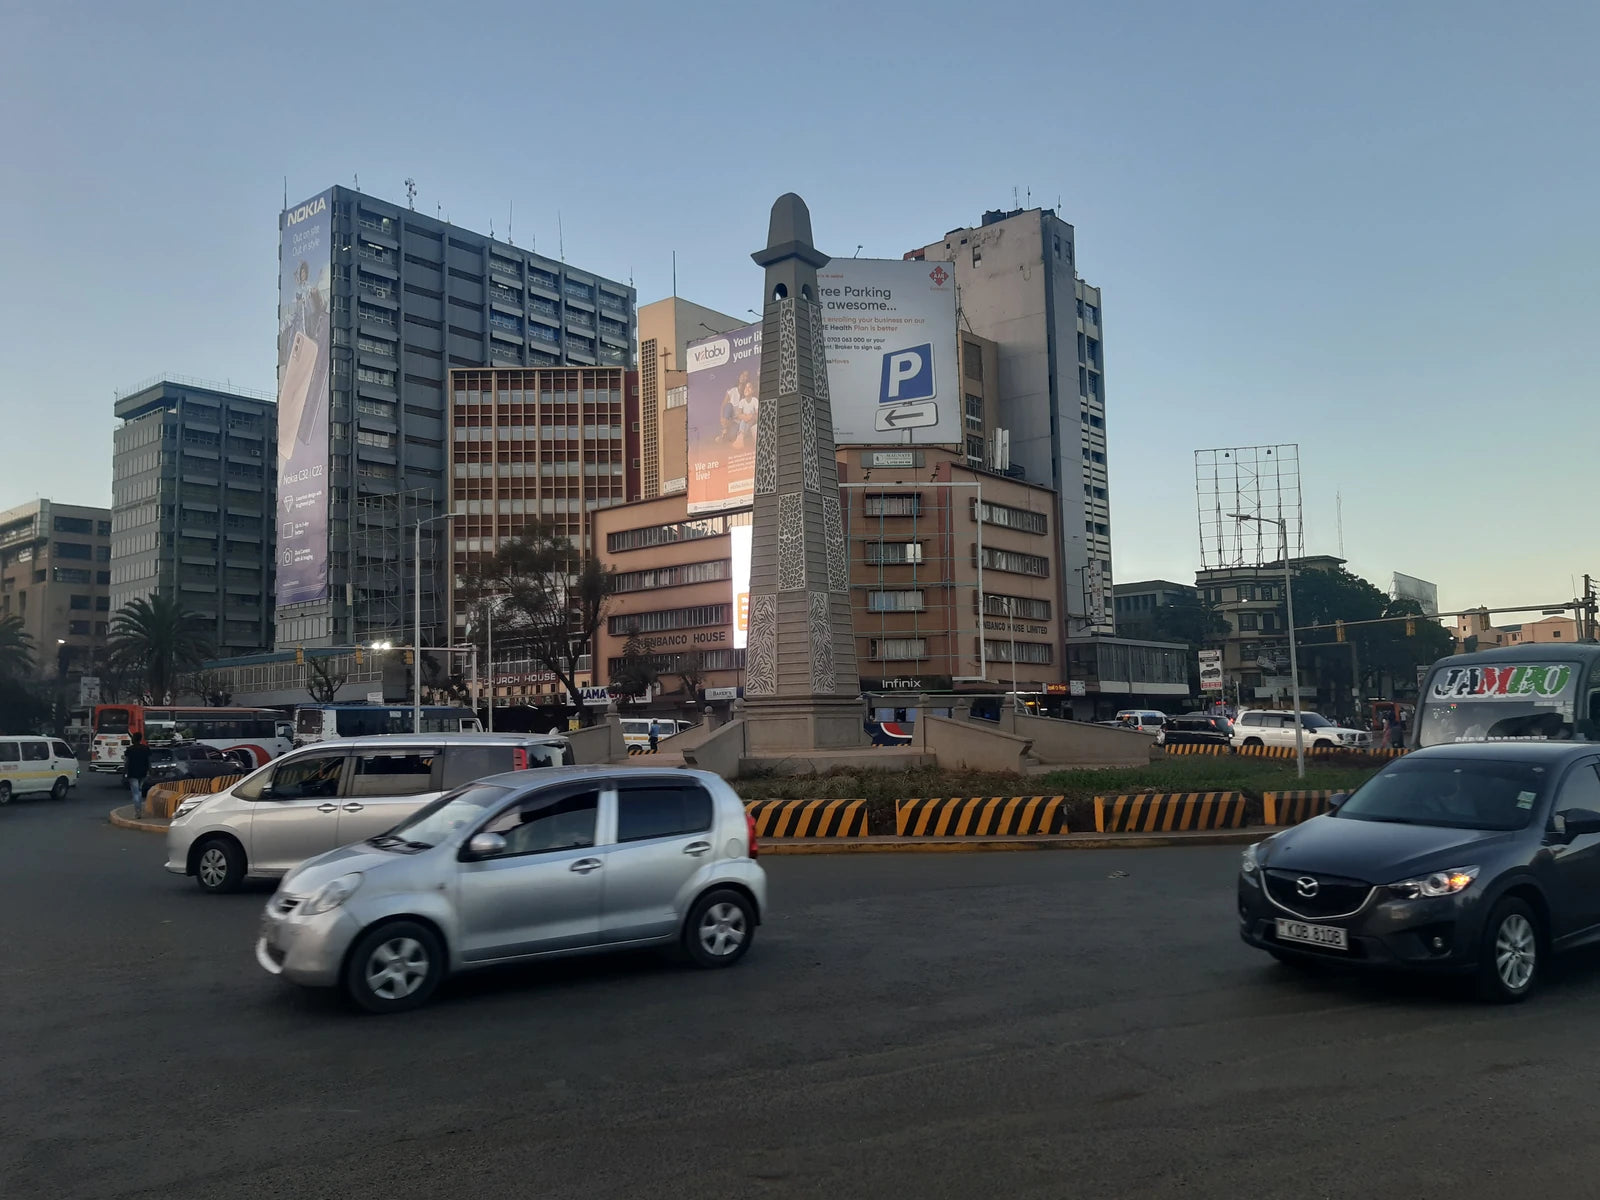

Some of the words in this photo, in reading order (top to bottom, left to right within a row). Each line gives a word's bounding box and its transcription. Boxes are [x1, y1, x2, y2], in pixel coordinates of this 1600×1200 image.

[287, 197, 326, 227] NOKIA
[844, 286, 892, 300] Parking
[827, 302, 897, 311] awesome...
[733, 335, 752, 348] Your
[733, 349, 752, 363] your
[694, 462, 706, 471] We
[707, 461, 719, 469] are
[283, 473, 298, 485] Nokia
[975, 620, 1006, 632] KNBANCO
[1007, 624, 1025, 633] HUSE
[1026, 625, 1048, 635] LIMITED
[693, 631, 726, 643] HOUSE
[524, 672, 557, 682] HOUSE
[882, 678, 921, 688] Infinix
[1434, 664, 1572, 698] JAMBO
